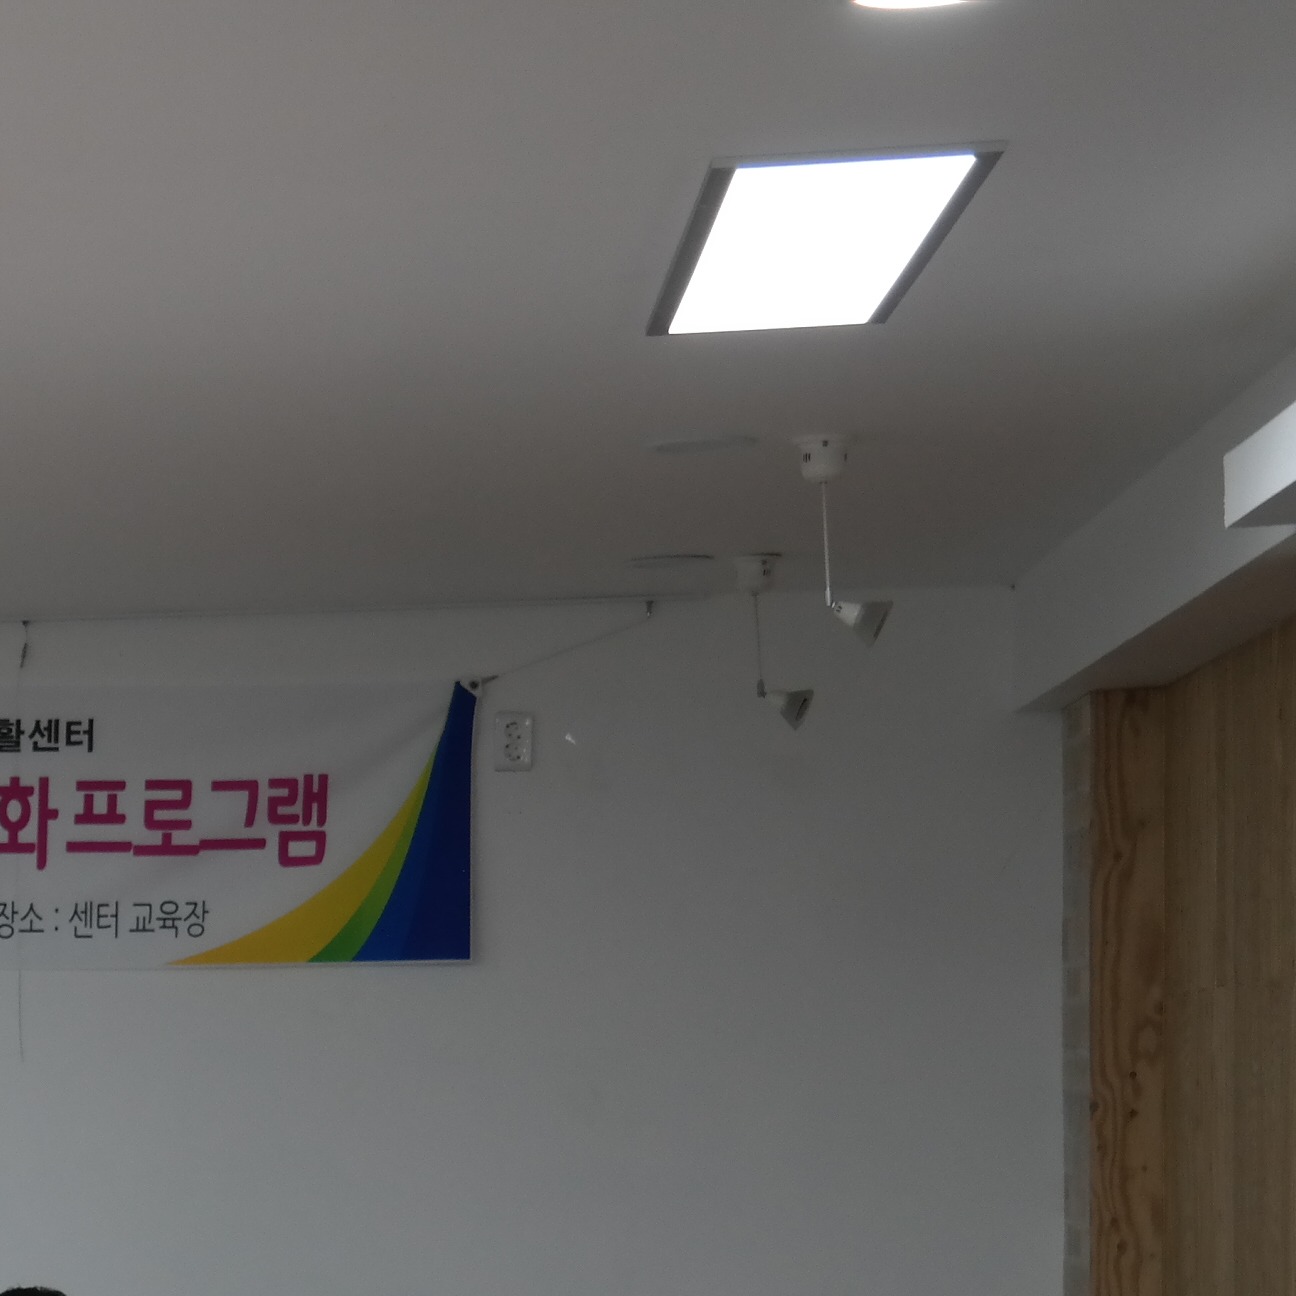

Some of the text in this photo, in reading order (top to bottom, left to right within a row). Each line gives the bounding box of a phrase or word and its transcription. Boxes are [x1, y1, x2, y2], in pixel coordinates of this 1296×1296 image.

[65, 773, 330, 868] 프로그램
[68, 900, 119, 939] 센터
[128, 899, 210, 939] 교육장
